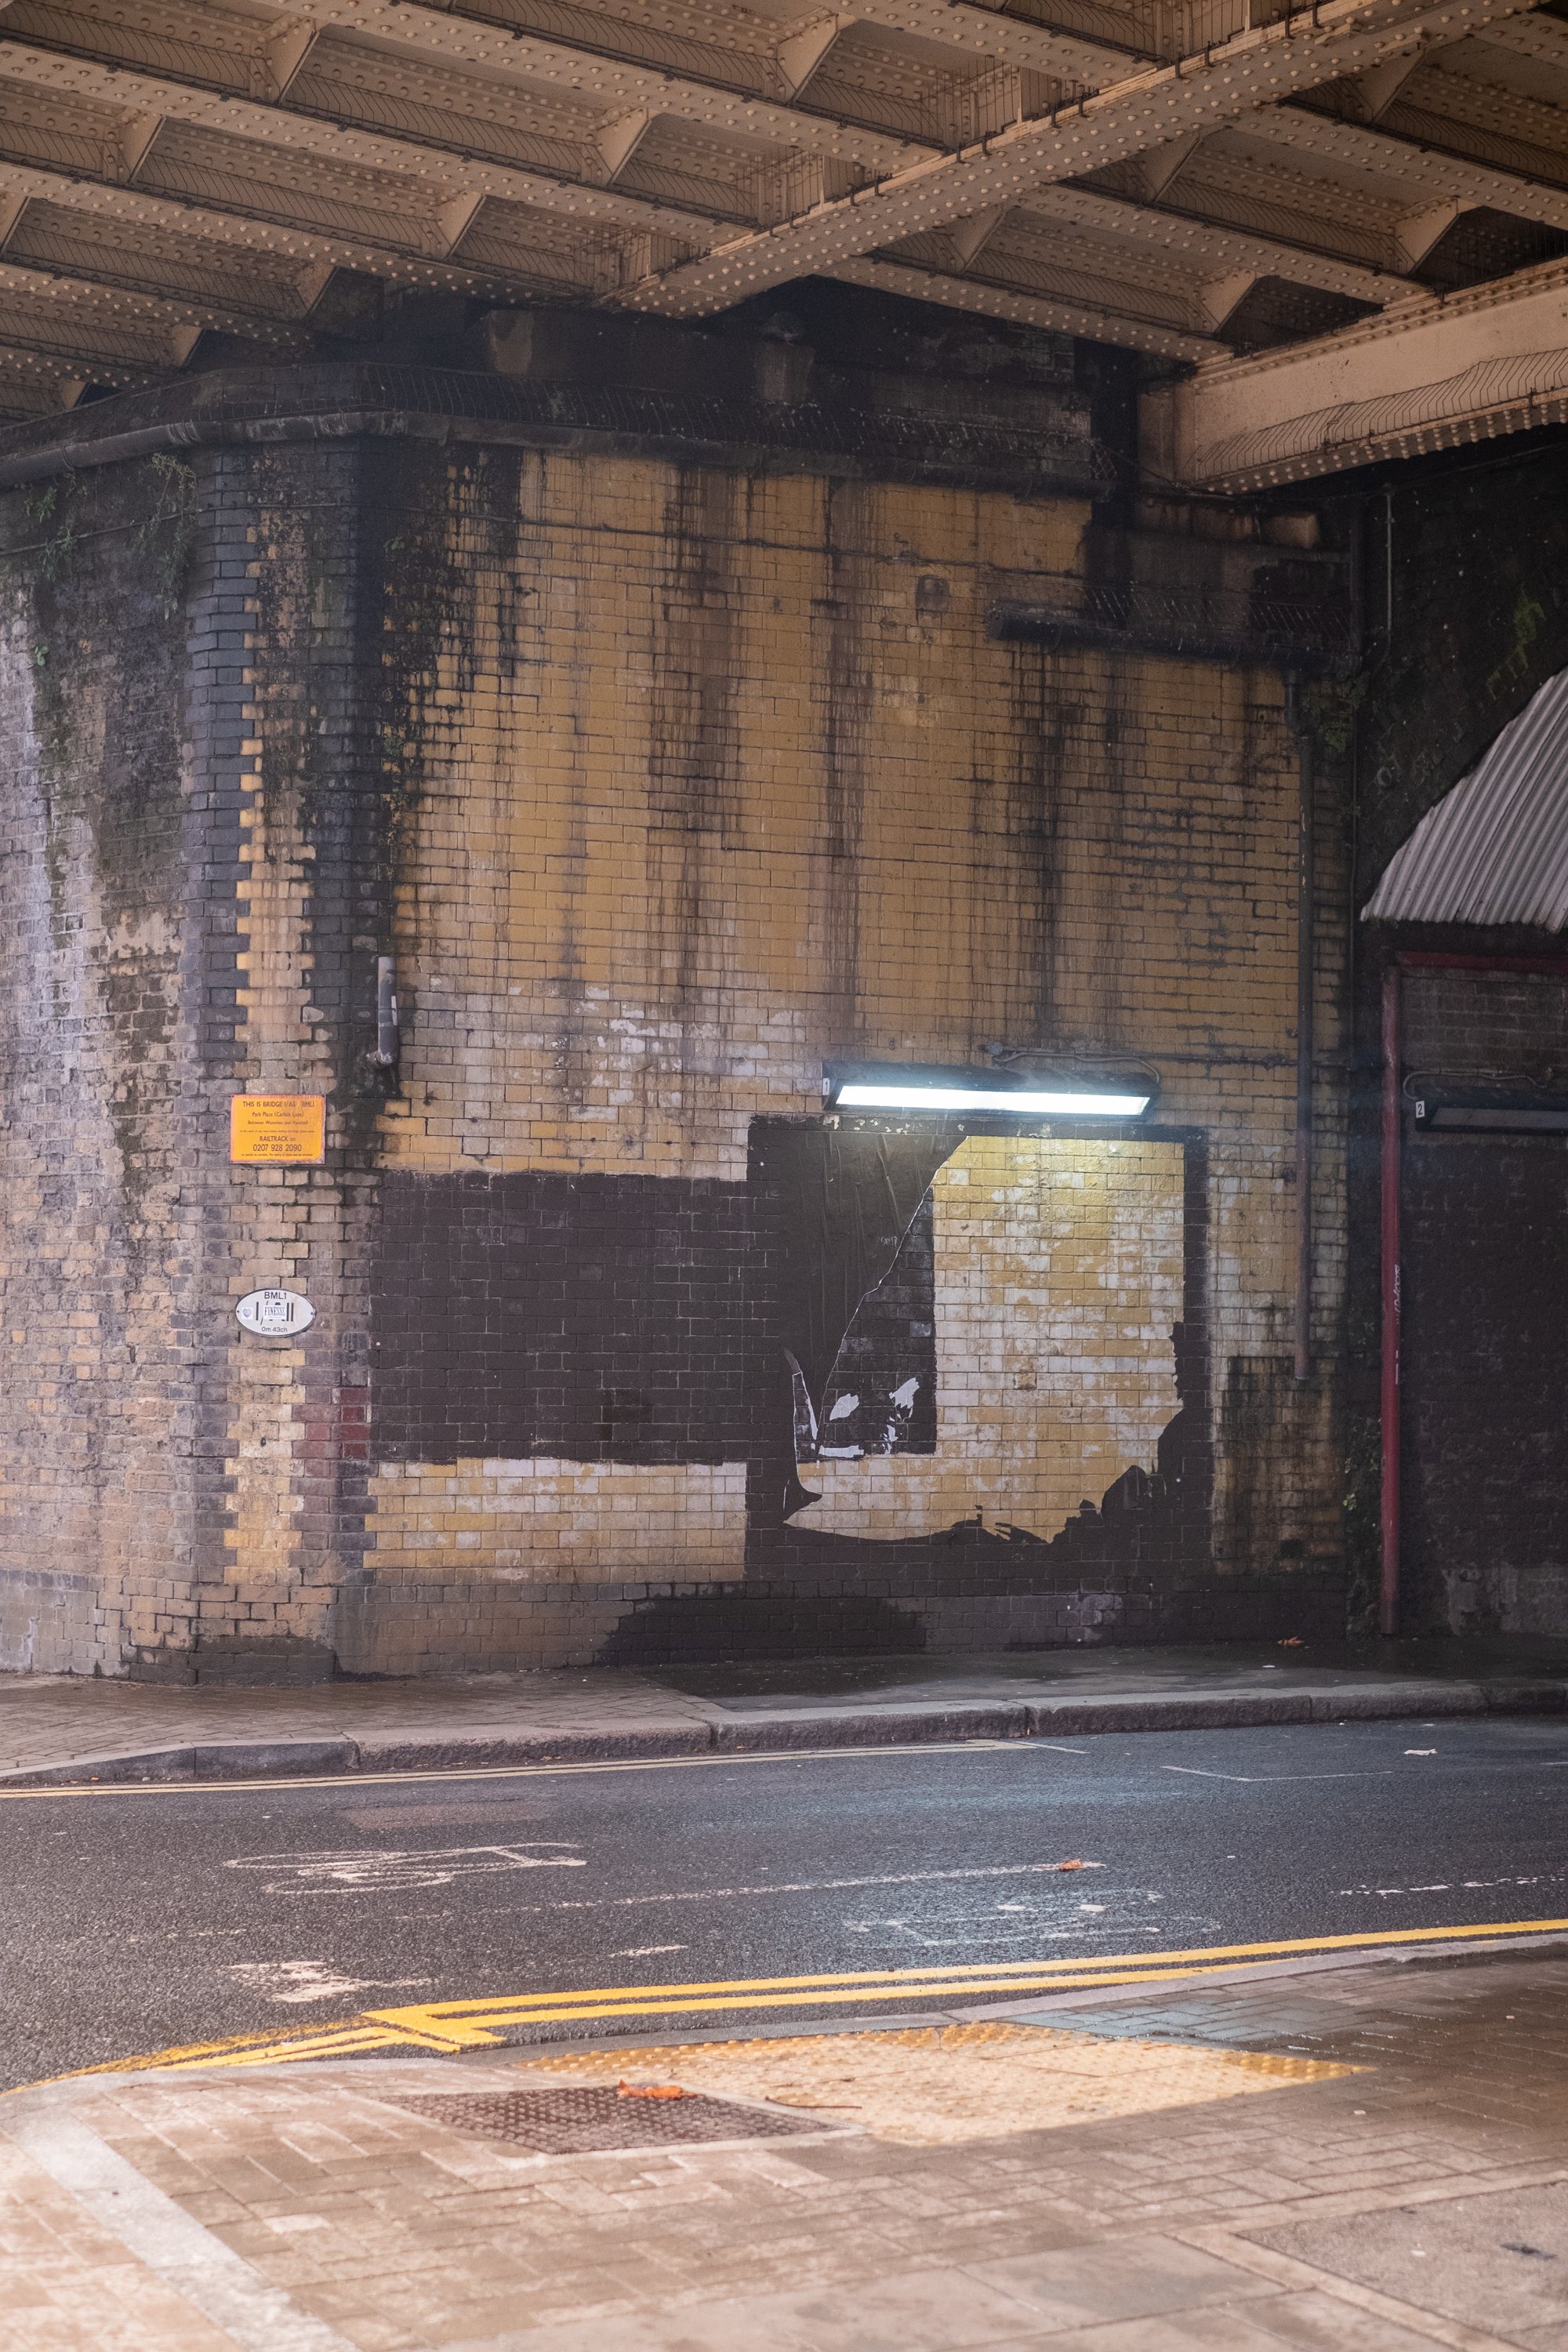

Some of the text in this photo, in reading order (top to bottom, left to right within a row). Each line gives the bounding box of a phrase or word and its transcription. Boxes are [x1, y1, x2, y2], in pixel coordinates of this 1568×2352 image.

[825, 1080, 828, 1092] 1
[1417, 1103, 1423, 1116] 2
[264, 1306, 286, 1316] FINESSE
